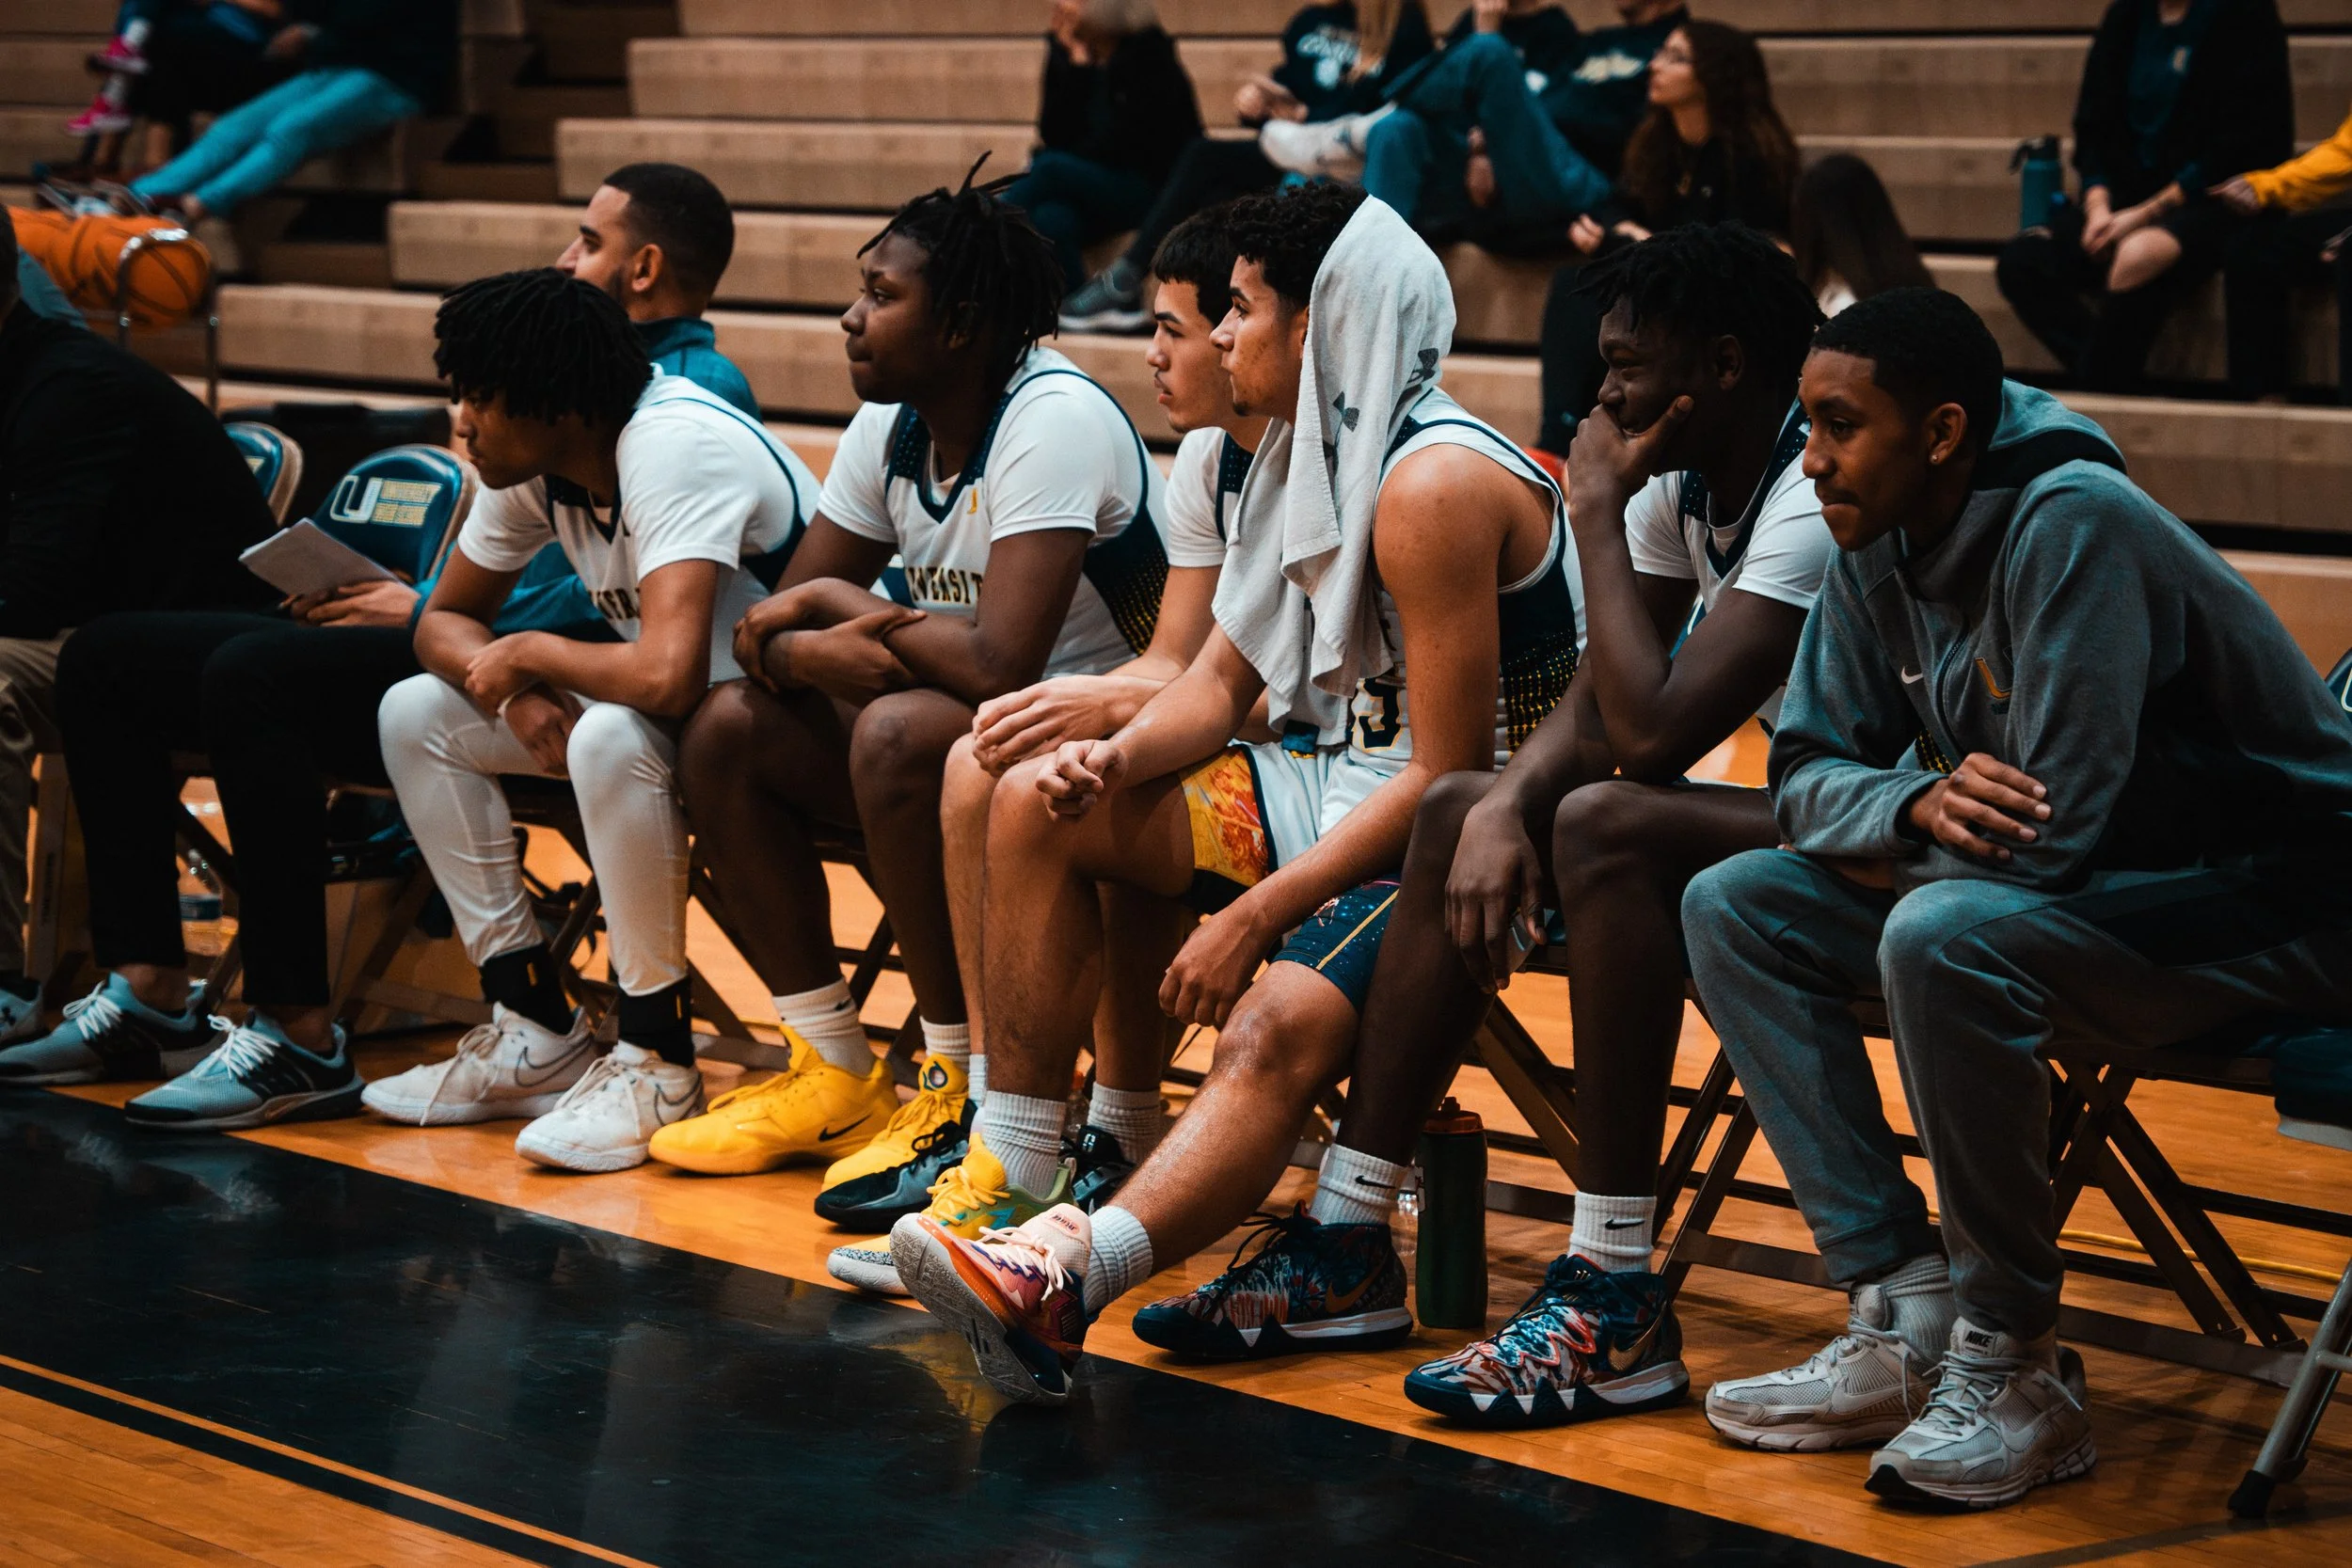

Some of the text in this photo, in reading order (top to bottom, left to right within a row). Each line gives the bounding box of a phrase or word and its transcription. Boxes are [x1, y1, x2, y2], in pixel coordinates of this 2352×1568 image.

[330, 475, 383, 524] U
[1348, 672, 1402, 750] 3
[1964, 1330, 1994, 1348] NIKE
